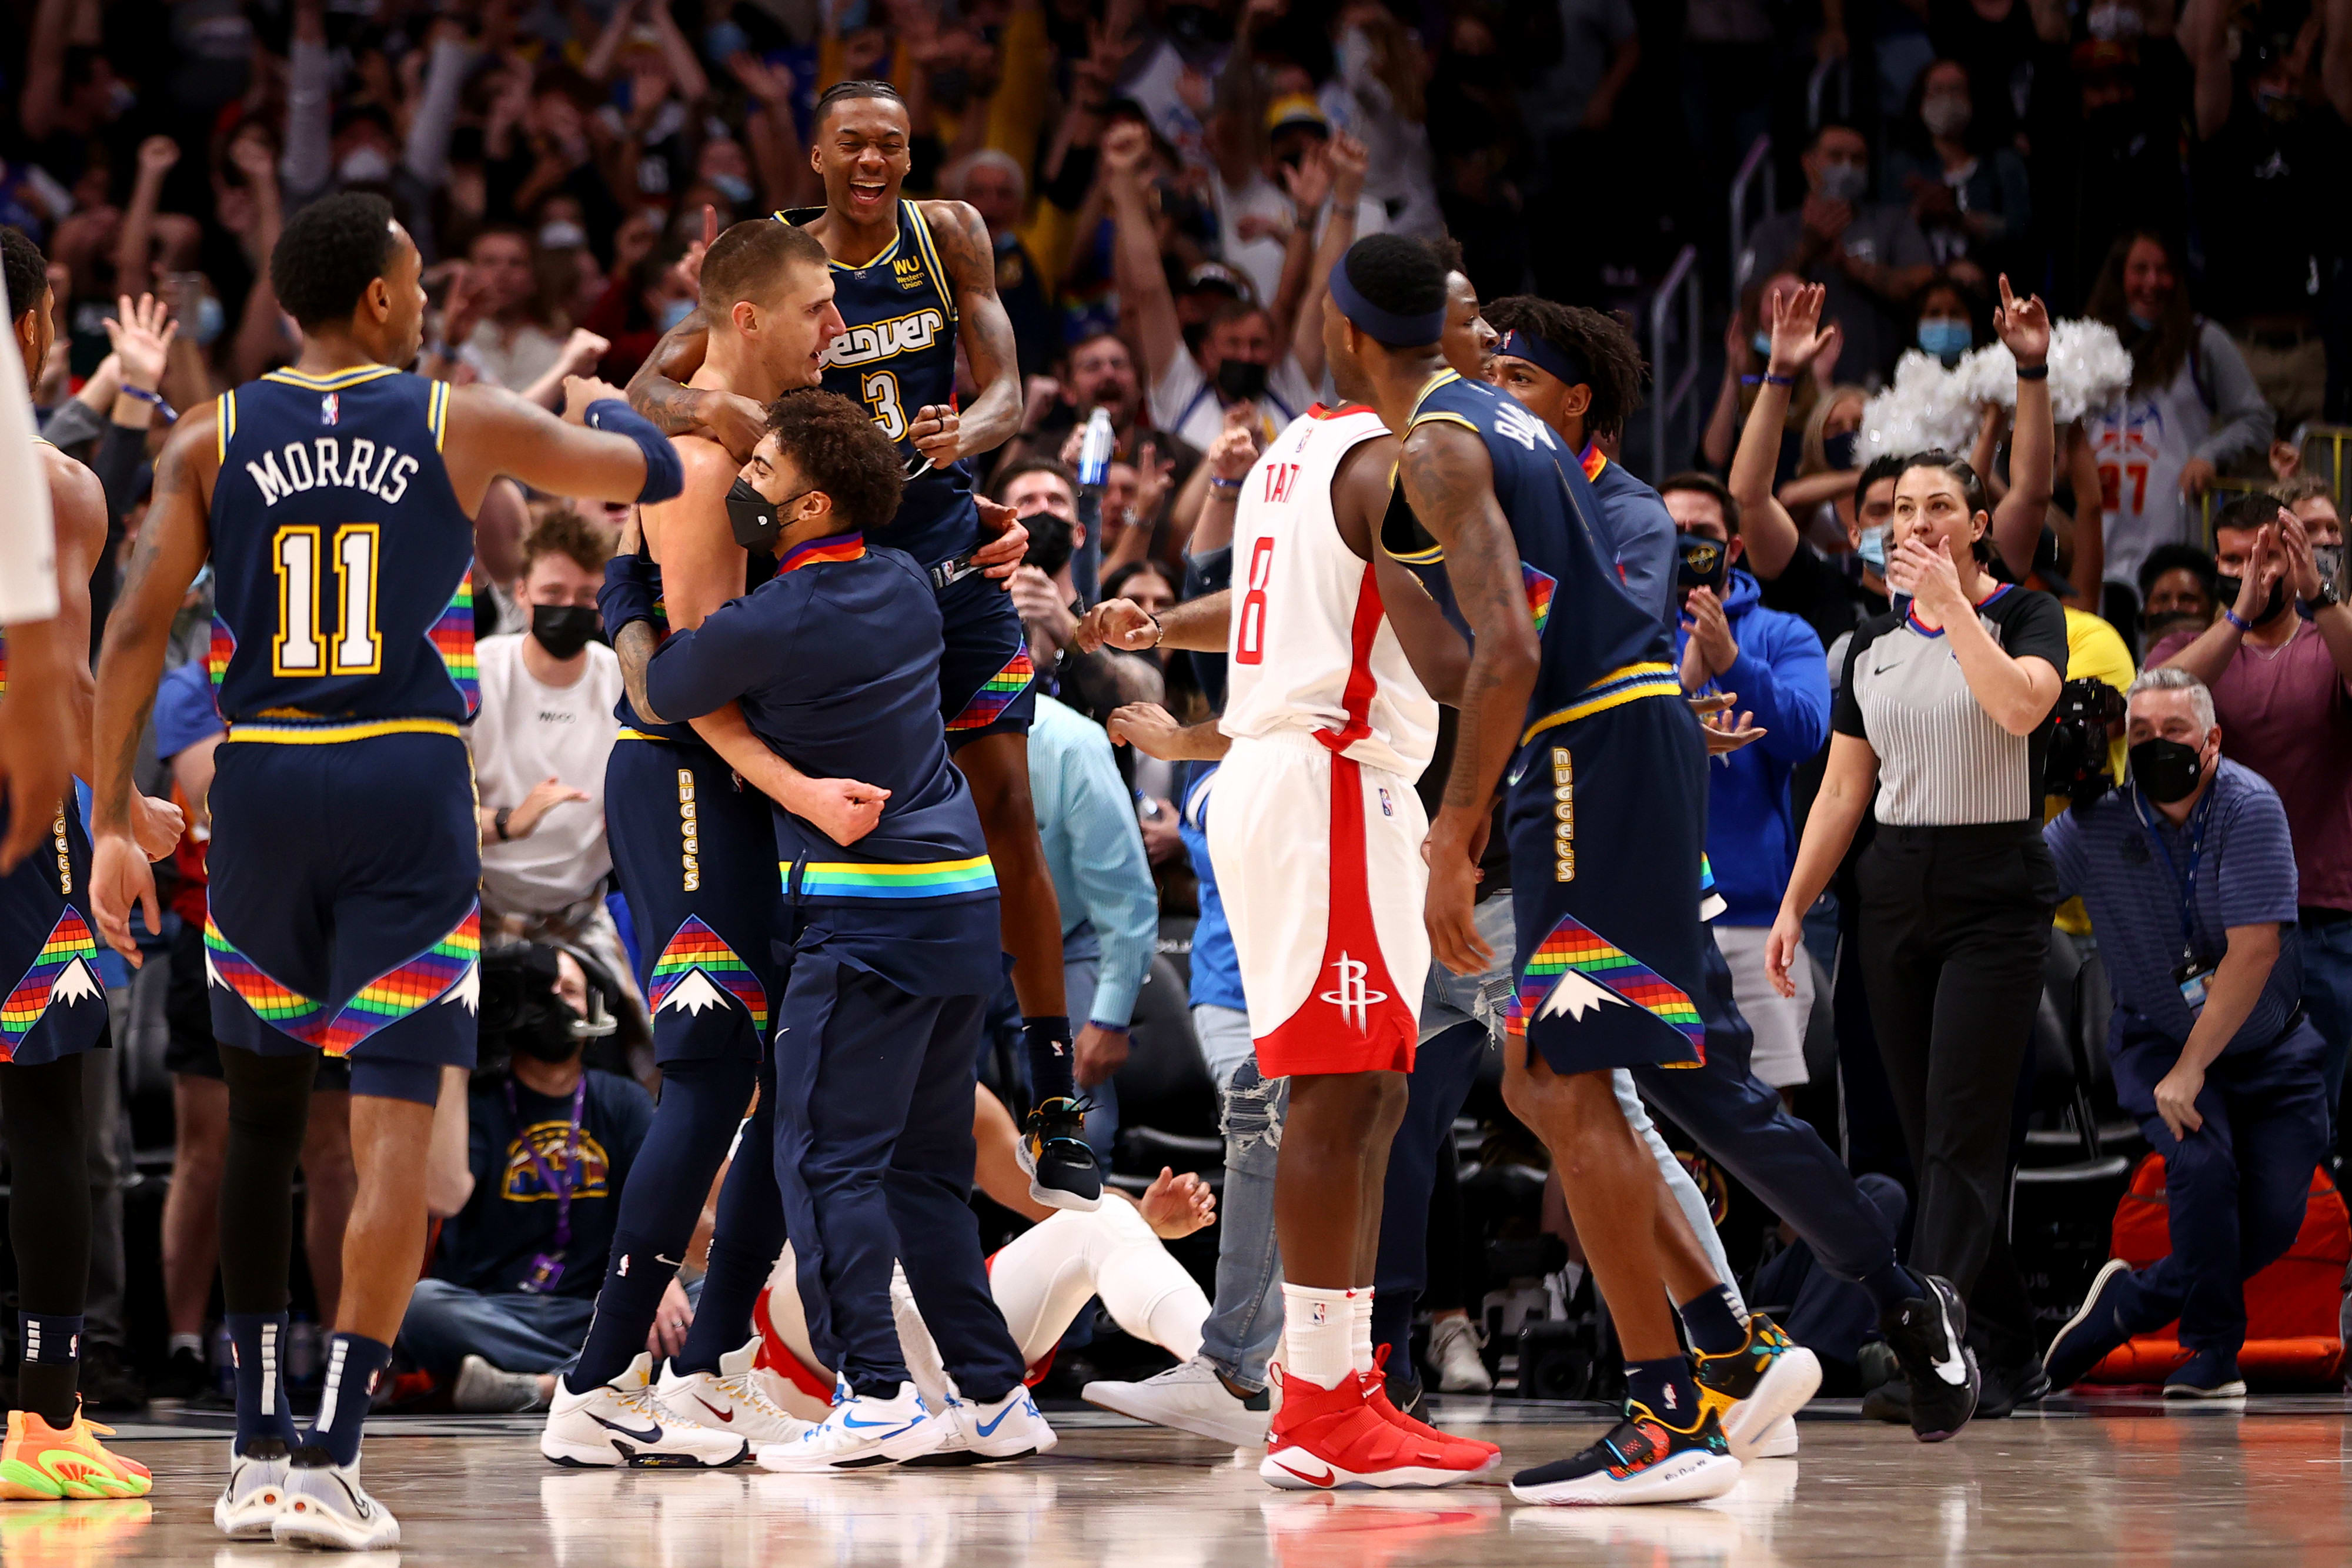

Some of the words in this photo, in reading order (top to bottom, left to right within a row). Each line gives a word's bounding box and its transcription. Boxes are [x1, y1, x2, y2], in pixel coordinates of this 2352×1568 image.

[892, 255, 920, 275] WU
[896, 272, 925, 283] Western
[902, 280, 923, 290] Union
[861, 370, 908, 442] 3
[245, 436, 419, 507] MORRIS
[1264, 463, 1302, 504] TAT
[272, 523, 382, 677] 11
[1236, 537, 1275, 666] 8
